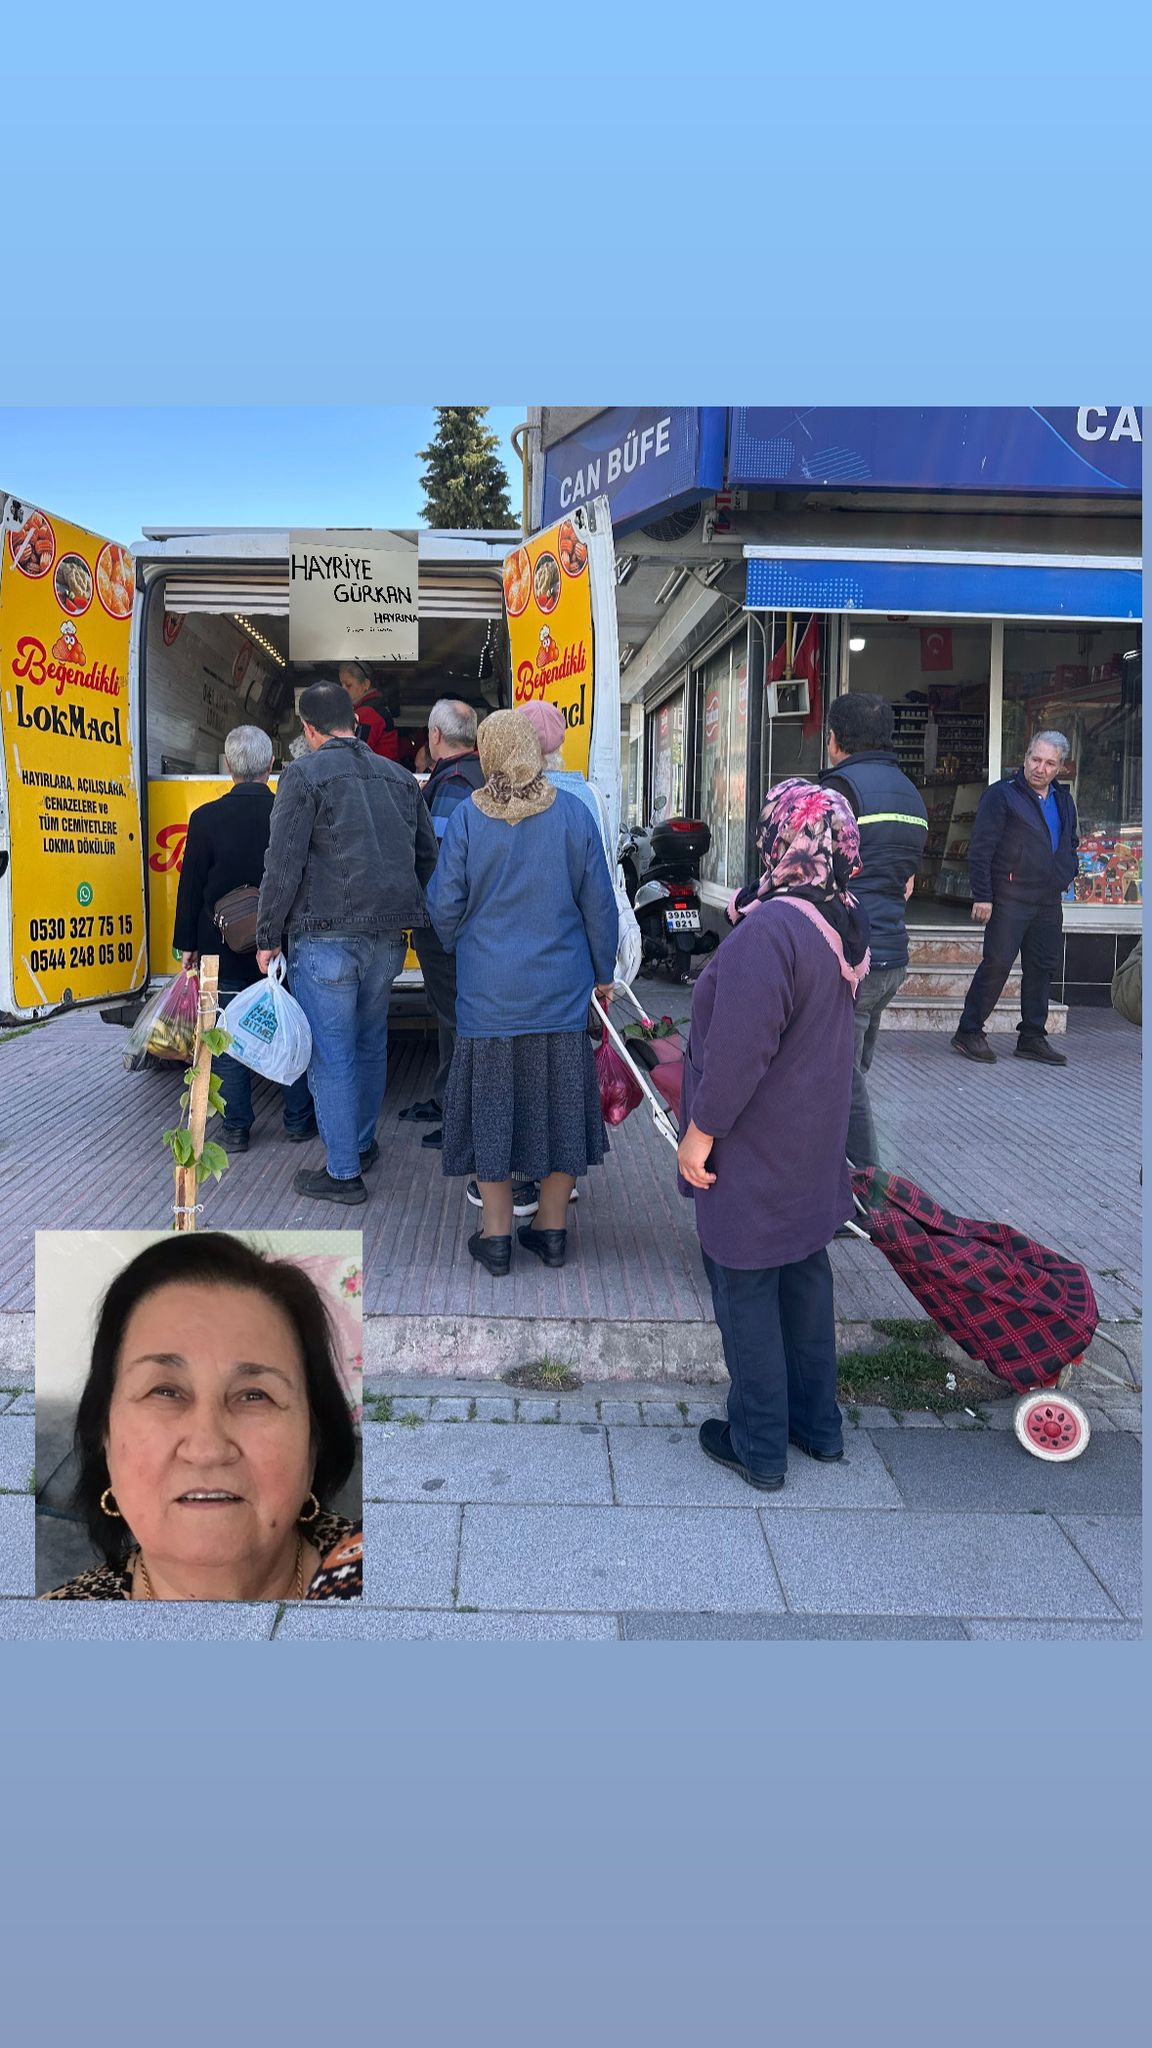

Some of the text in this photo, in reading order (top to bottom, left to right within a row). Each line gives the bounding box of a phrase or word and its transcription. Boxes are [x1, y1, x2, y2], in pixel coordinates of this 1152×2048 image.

[560, 416, 671, 508] CAN BÜFE
[291, 553, 373, 581] HAYRİYE
[333, 583, 412, 604] GÜRKAN
[11, 636, 120, 696] Beğendikli
[515, 640, 586, 702] Beğendikli
[44, 796, 109, 814] CENAZELERE ve
[38, 813, 118, 835] TÜM CEMİYETLERE
[43, 837, 116, 855] LOKMA DÖKÜLÜR
[30, 914, 133, 942] 0530 327 75 15
[30, 942, 133, 973] 0544 248 05 80
